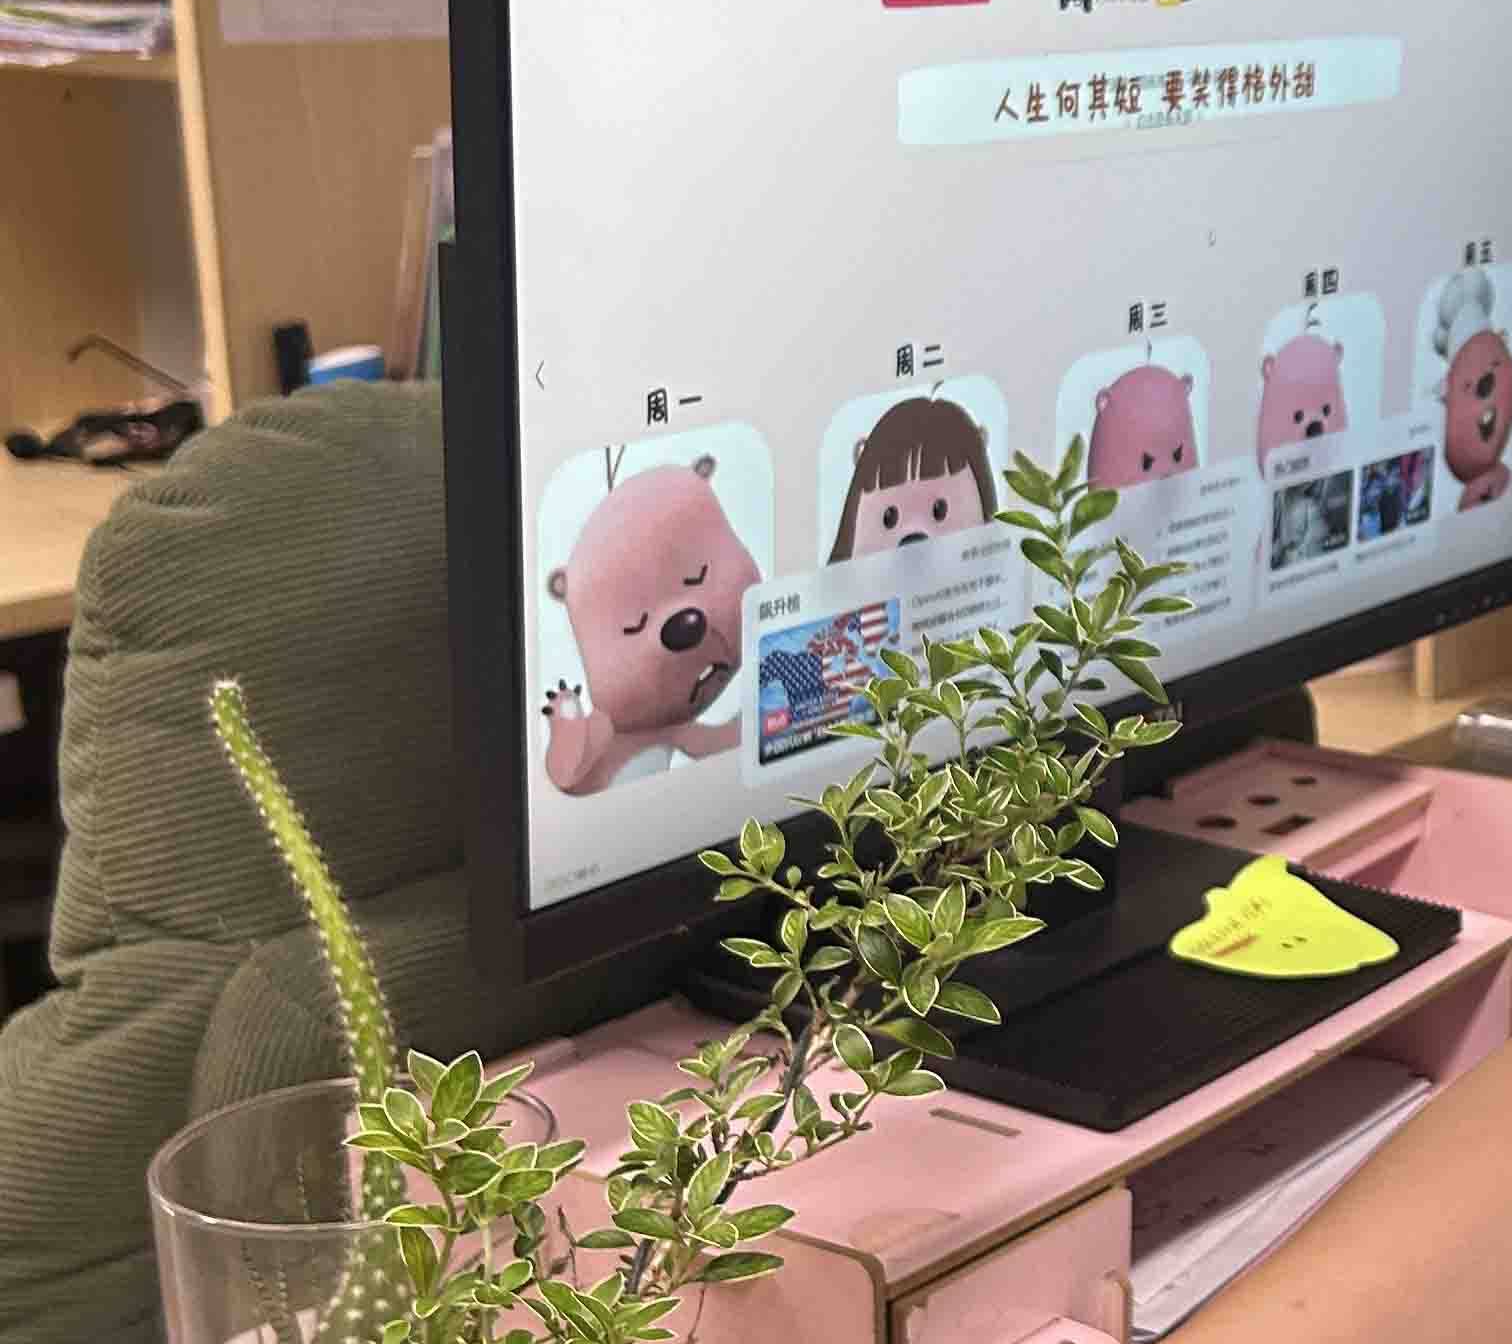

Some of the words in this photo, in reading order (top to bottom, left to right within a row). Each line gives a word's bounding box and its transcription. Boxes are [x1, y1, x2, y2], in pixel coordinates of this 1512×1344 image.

[1128, 302, 1168, 335] 周三
[896, 343, 944, 377] 周二
[647, 388, 702, 425] 周一
